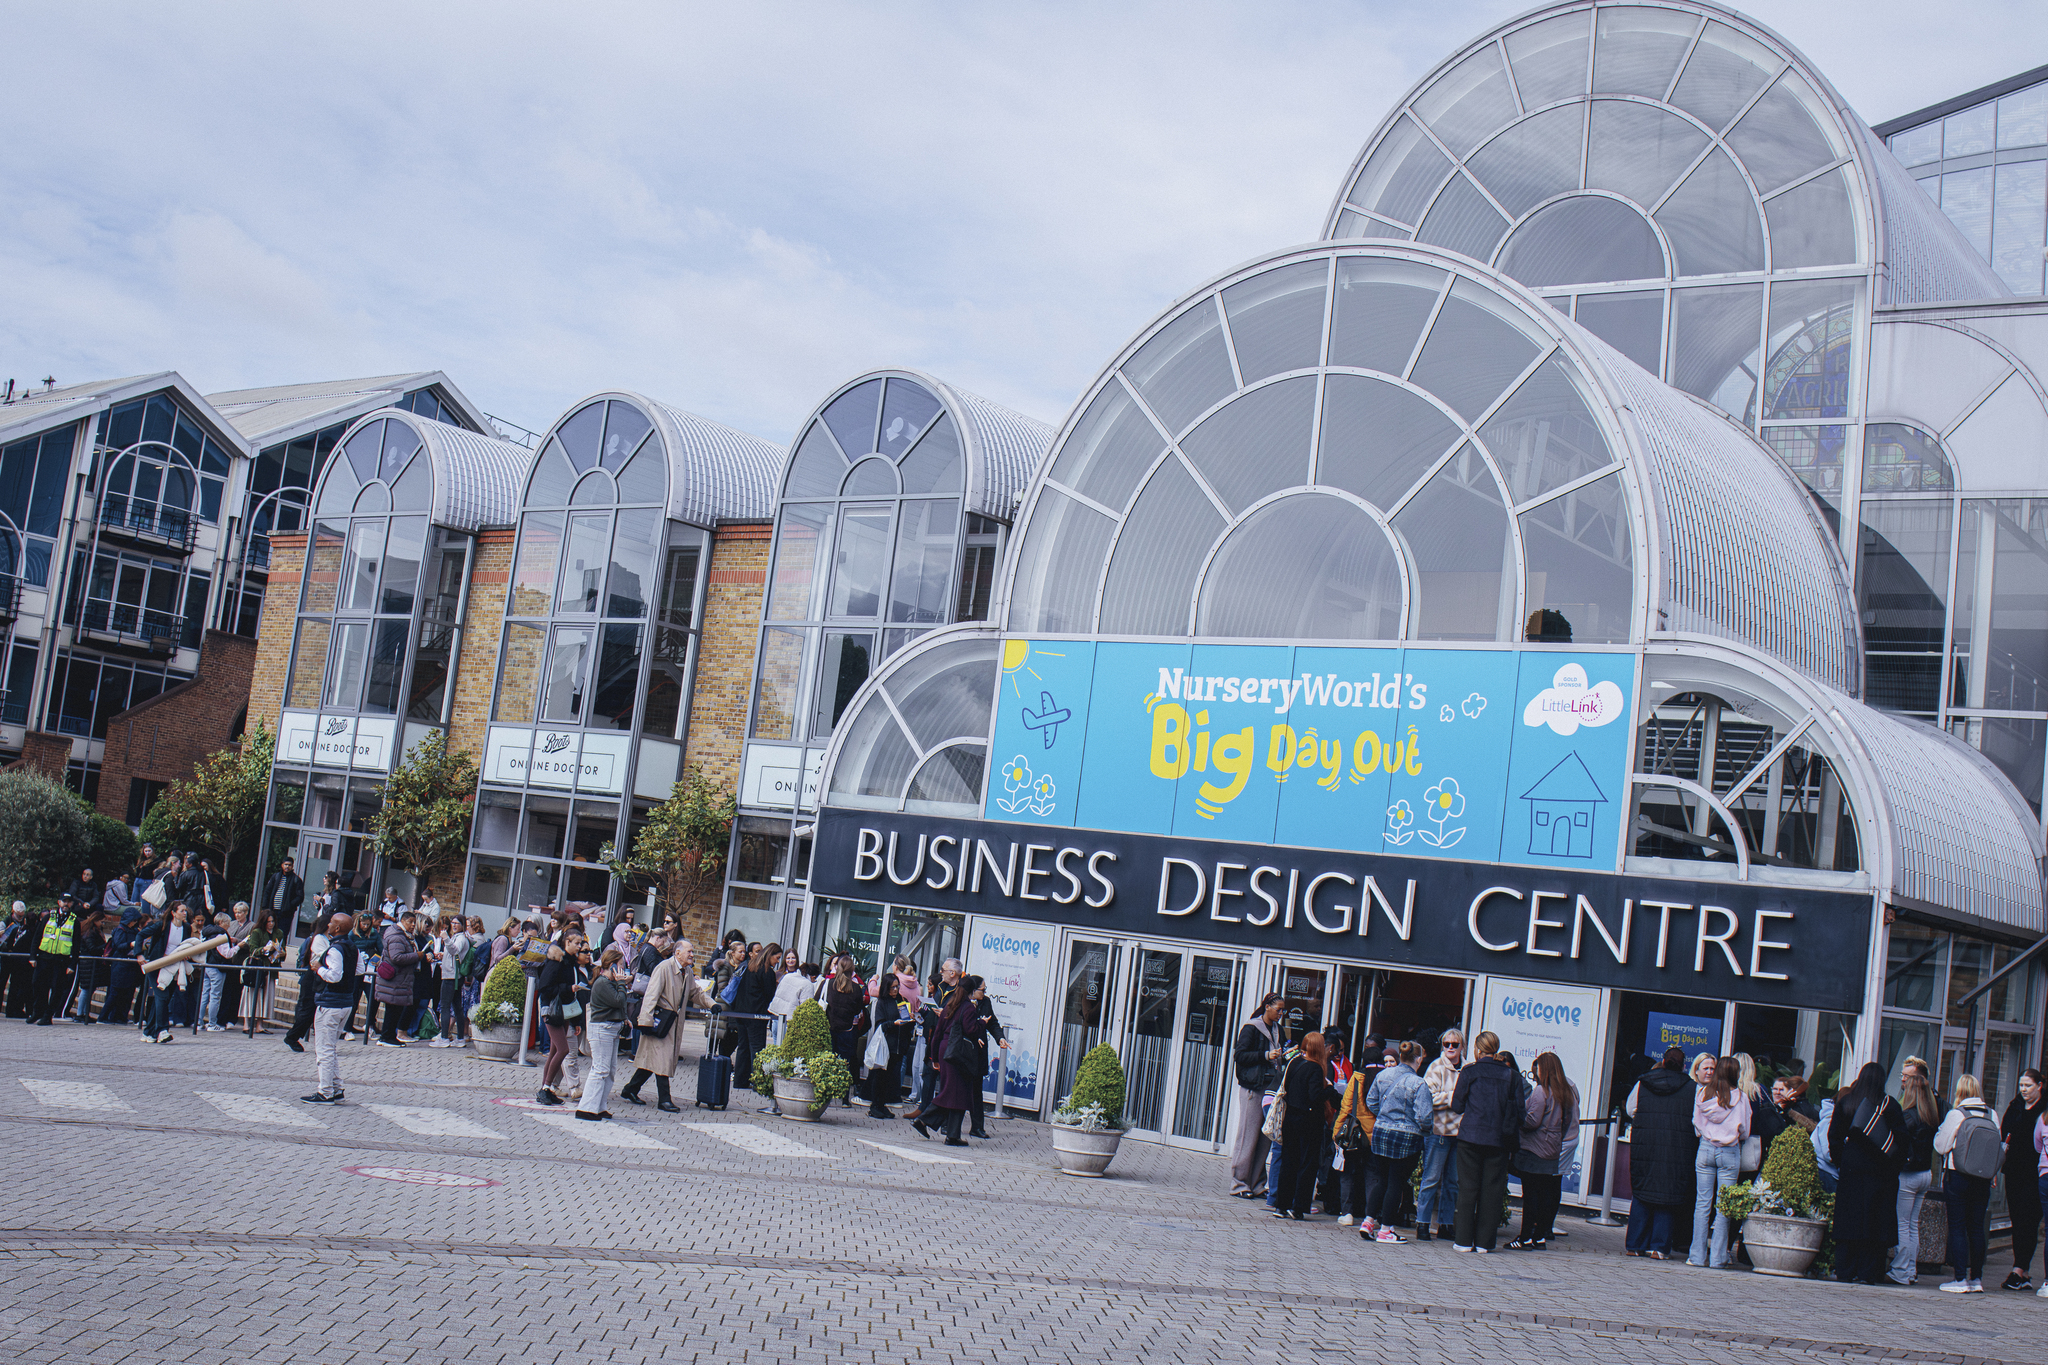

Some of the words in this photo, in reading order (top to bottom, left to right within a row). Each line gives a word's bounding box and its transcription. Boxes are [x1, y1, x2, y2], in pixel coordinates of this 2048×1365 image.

[1155, 667, 1427, 714] NurseryWorld's
[1542, 699, 1598, 713] LittleLink
[324, 717, 348, 736] Boots
[333, 744, 370, 755] DOCTOR
[542, 733, 570, 754] Boots
[1150, 703, 1254, 804] Big
[1266, 723, 1342, 787] Day
[1353, 730, 1422, 777] Out
[554, 763, 599, 775] DOCTOR
[775, 780, 817, 793] ONLIN
[853, 827, 1117, 908] BUSINESS
[1156, 856, 1417, 941] DESIGN
[1467, 886, 1794, 981] CENTRE
[990, 975, 1019, 987] LittleLink
[1662, 1022, 1709, 1034] NurseryWorld's
[1661, 1029, 1681, 1047] Big
[1681, 1034, 1695, 1046] Day
[1696, 1036, 1708, 1045] Out
